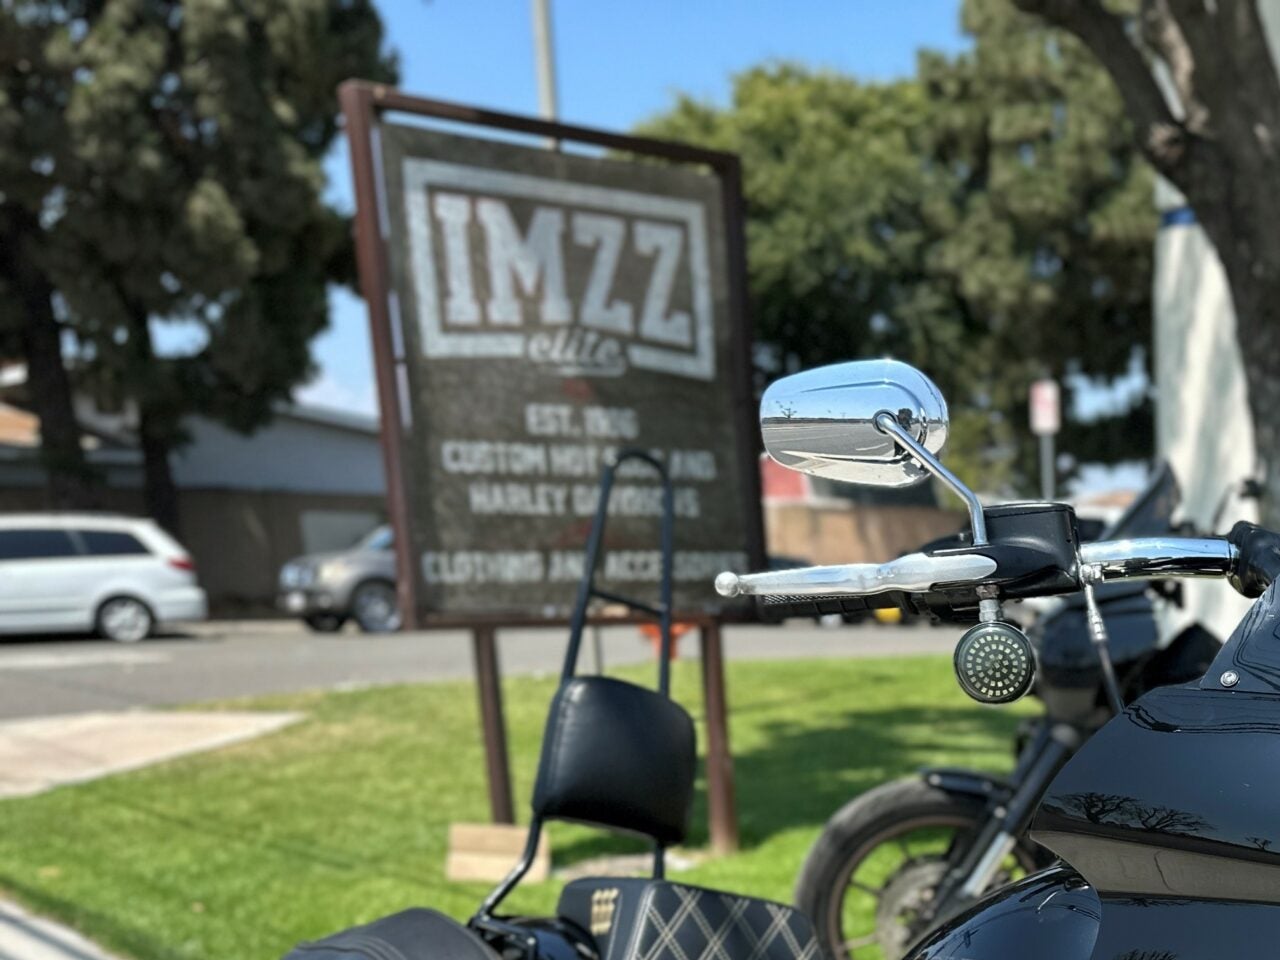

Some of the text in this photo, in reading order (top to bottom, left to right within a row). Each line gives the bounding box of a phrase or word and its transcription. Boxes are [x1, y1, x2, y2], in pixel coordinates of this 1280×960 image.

[433, 193, 692, 346] IMZZ
[442, 440, 545, 475] CUSTOM
[469, 482, 567, 515] HARLEY
